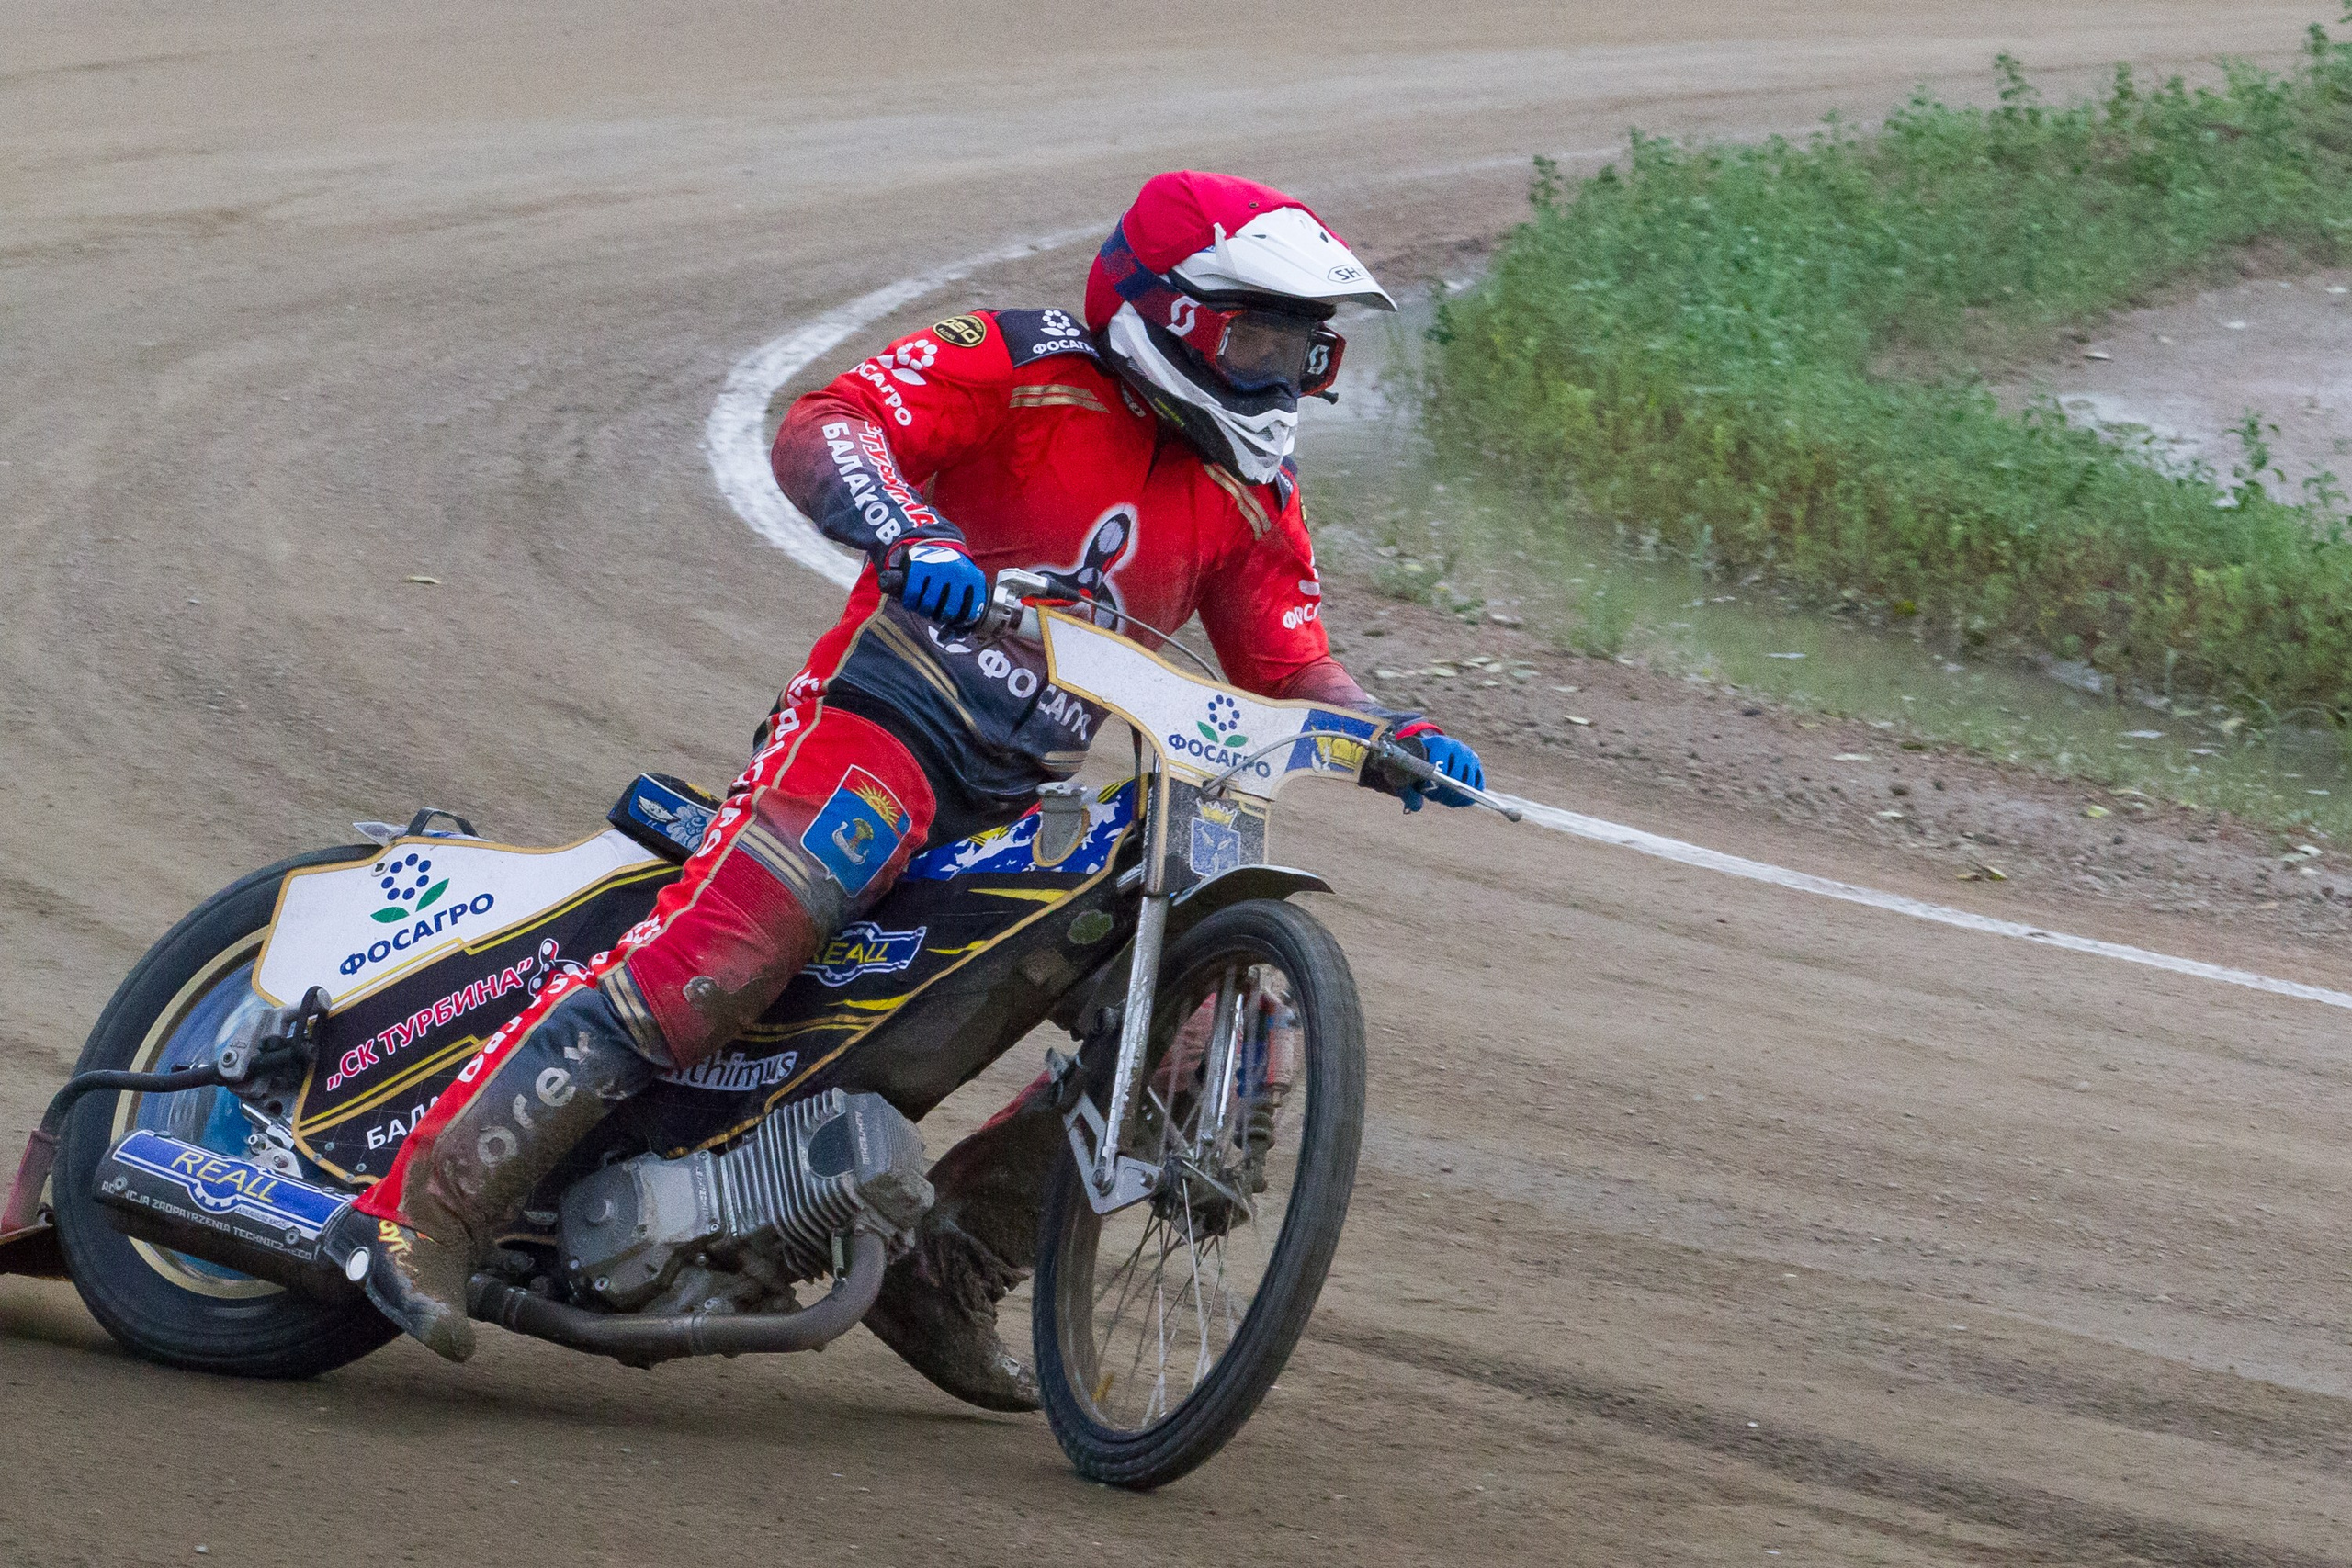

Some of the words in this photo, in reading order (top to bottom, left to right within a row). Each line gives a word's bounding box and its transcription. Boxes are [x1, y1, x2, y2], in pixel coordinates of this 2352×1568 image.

[339, 893, 494, 976] ФОСАГРО
[171, 1150, 279, 1203] REALL
[152, 1198, 231, 1233] ZAOPATRZENIA
